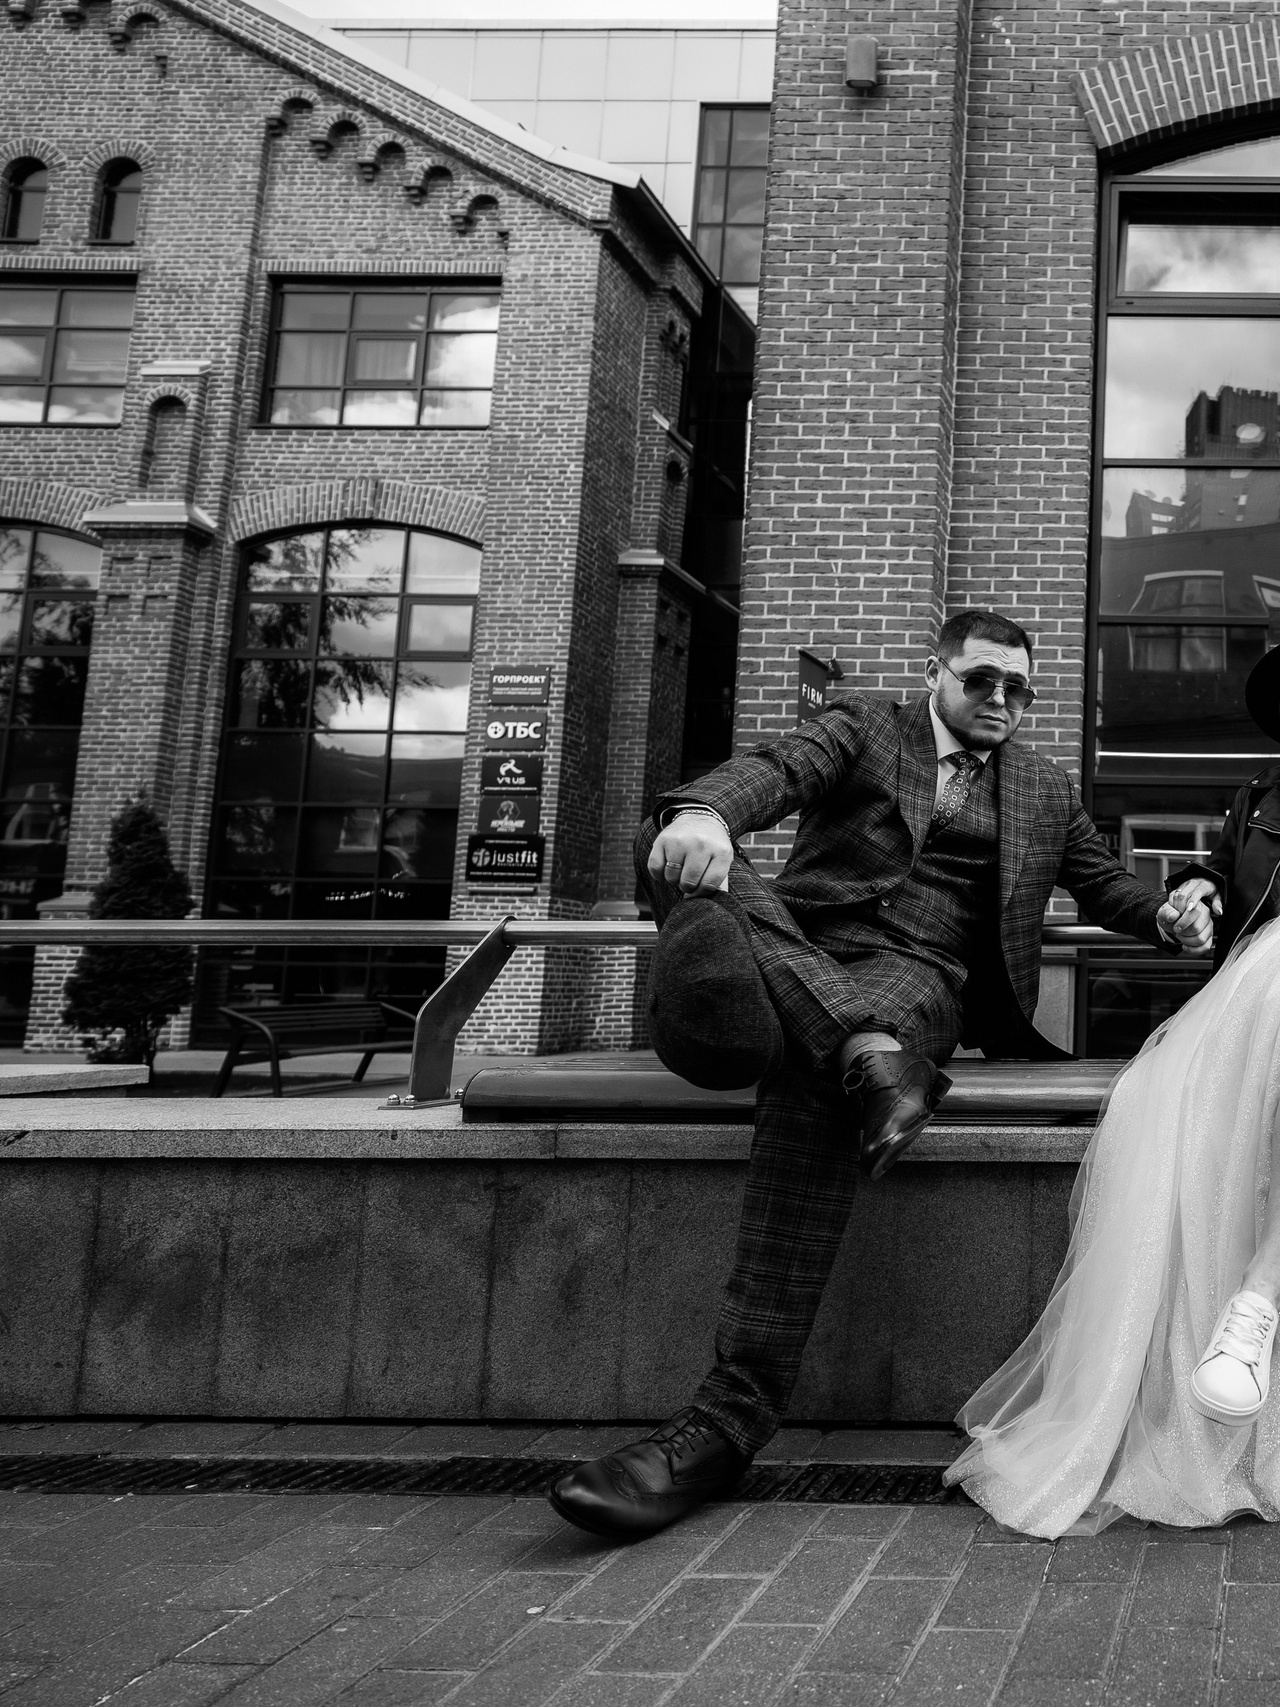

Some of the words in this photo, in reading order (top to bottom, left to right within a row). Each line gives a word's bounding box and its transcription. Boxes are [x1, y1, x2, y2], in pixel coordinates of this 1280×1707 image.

[492, 675, 546, 684] ГОРПРОЕКТ
[802, 683, 823, 706] FIRM
[504, 721, 541, 738] ТБС
[491, 850, 538, 866] justfit
